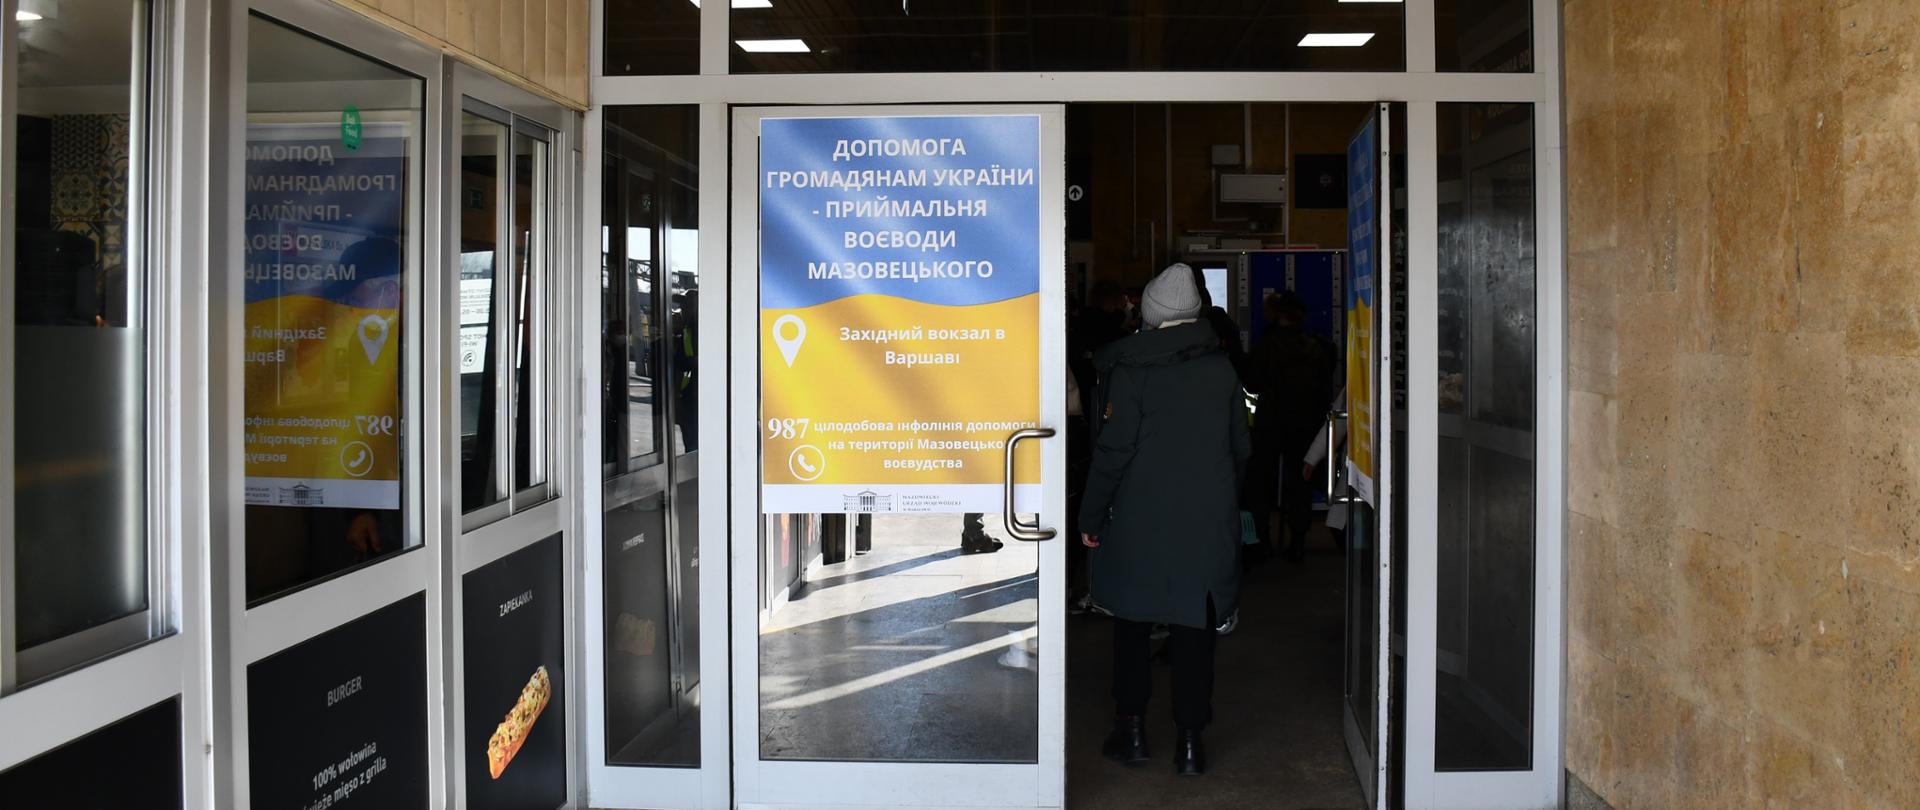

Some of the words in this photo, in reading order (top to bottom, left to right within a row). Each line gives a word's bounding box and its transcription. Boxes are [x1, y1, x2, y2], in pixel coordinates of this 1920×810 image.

[832, 138, 967, 161] ДОПОМОГА
[766, 169, 927, 191] ГРОМАДЯНАМ
[933, 165, 1034, 187] УКРАЇНИ
[825, 195, 987, 218] ПРИЙМАЛЬНЯ
[844, 230, 956, 252] ВОЄВОДИ
[808, 261, 993, 283] МАЗОВЕЦЬКОГО
[839, 326, 922, 343] Західний
[928, 329, 991, 341] вокзал
[996, 328, 1005, 340] в
[885, 350, 960, 368] Варшаві
[768, 417, 809, 440] 987
[814, 420, 893, 434] цілодобова
[897, 419, 963, 434] інфолінія
[966, 421, 1036, 433] допомоги
[828, 441, 845, 450] на
[849, 439, 914, 453] території
[917, 438, 1019, 451] Мазовецько
[883, 459, 963, 471] воєвудства
[327, 675, 362, 707] BURGER
[313, 763, 338, 791] 100%
[338, 742, 377, 775] wołowina
[334, 777, 359, 802] mięso
[366, 756, 387, 784] grilla
